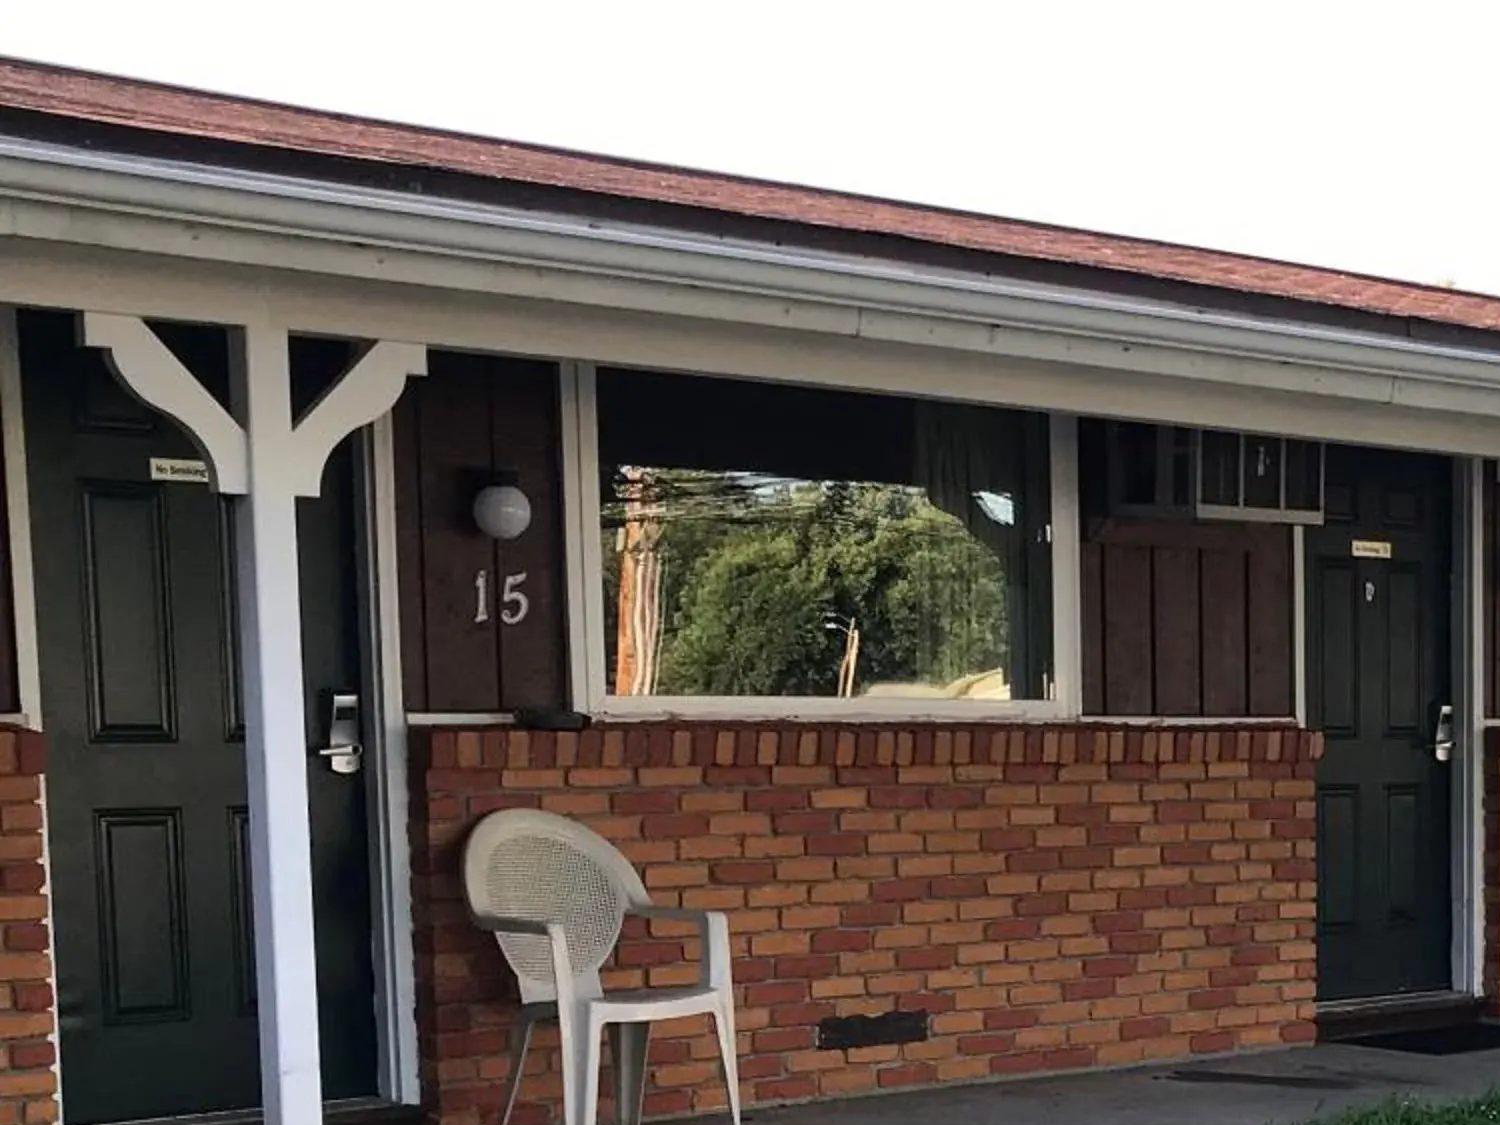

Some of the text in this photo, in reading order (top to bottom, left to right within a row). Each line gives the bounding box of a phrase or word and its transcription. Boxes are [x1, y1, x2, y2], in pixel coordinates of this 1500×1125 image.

[155, 463, 207, 478] No Smoking
[475, 570, 529, 624] 15
